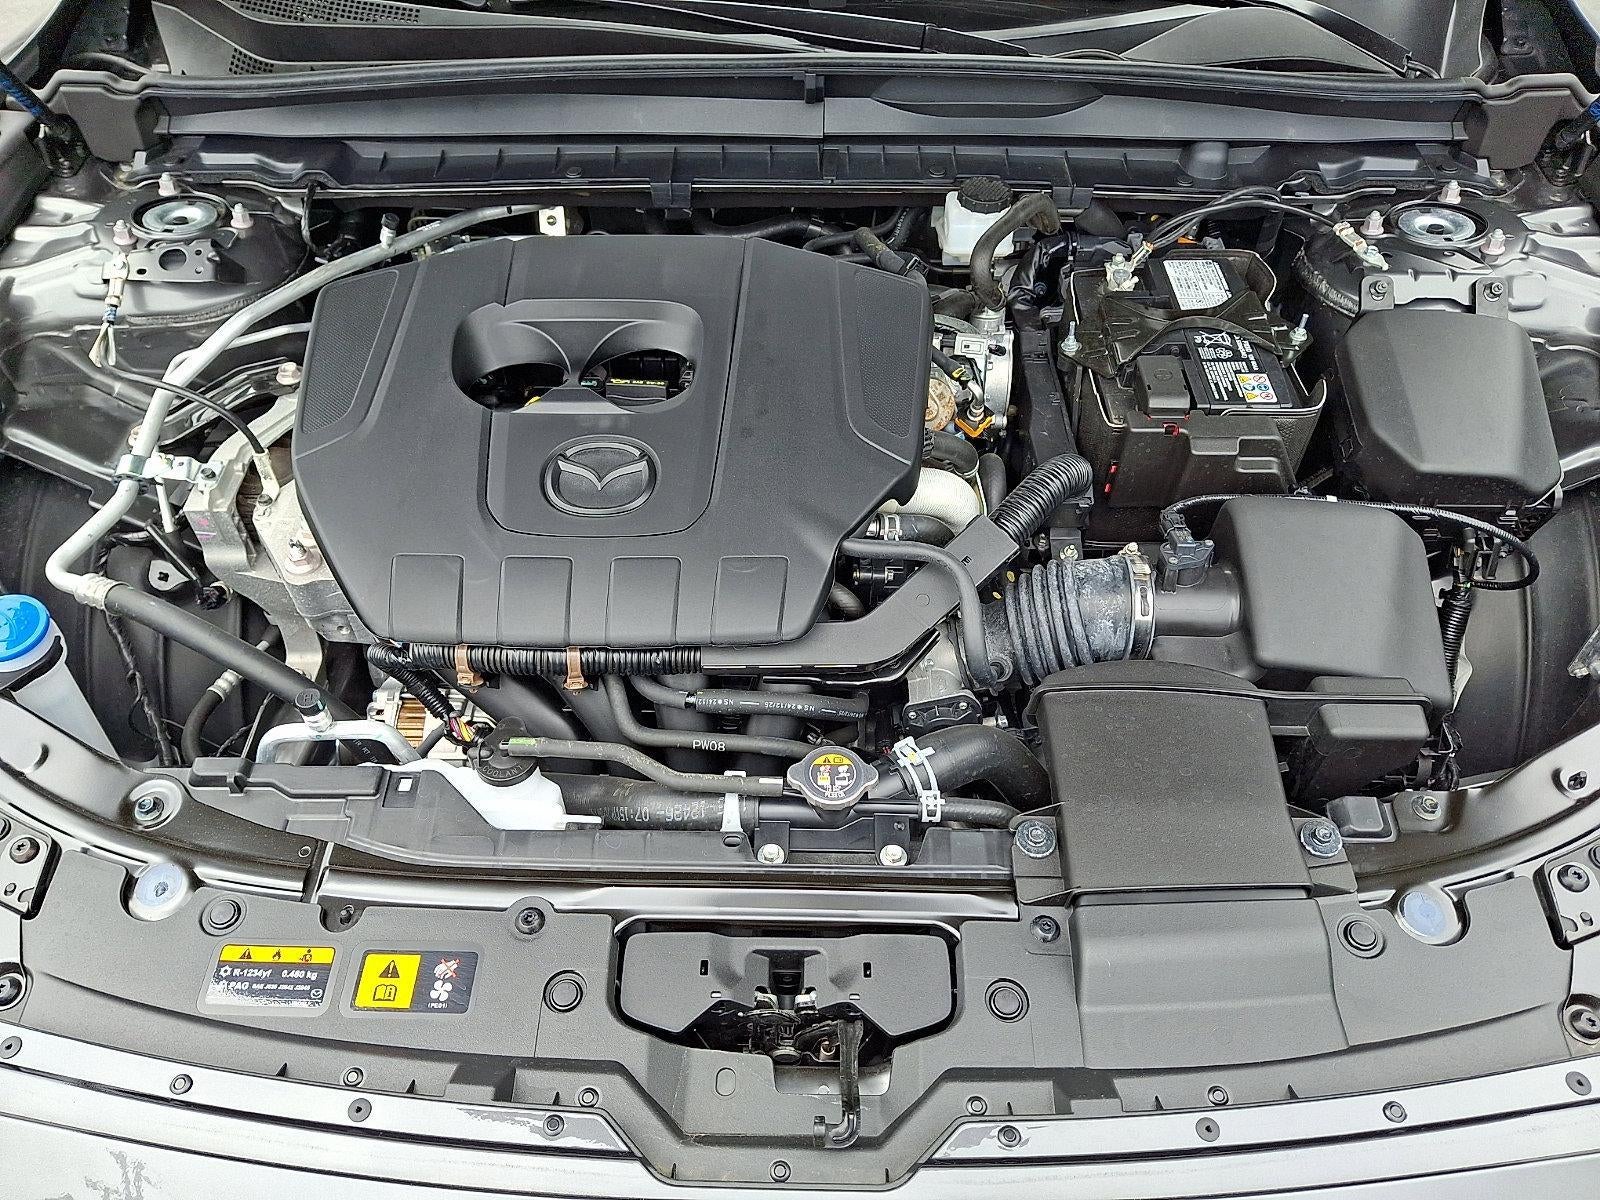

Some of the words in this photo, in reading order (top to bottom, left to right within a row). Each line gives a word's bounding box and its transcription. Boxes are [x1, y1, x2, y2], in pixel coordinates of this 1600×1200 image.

[692, 739, 726, 752] PW08
[482, 764, 522, 778] COOLANT
[232, 968, 273, 980] R-1234yf
[305, 969, 318, 981] kg
[228, 981, 250, 991] PAG
